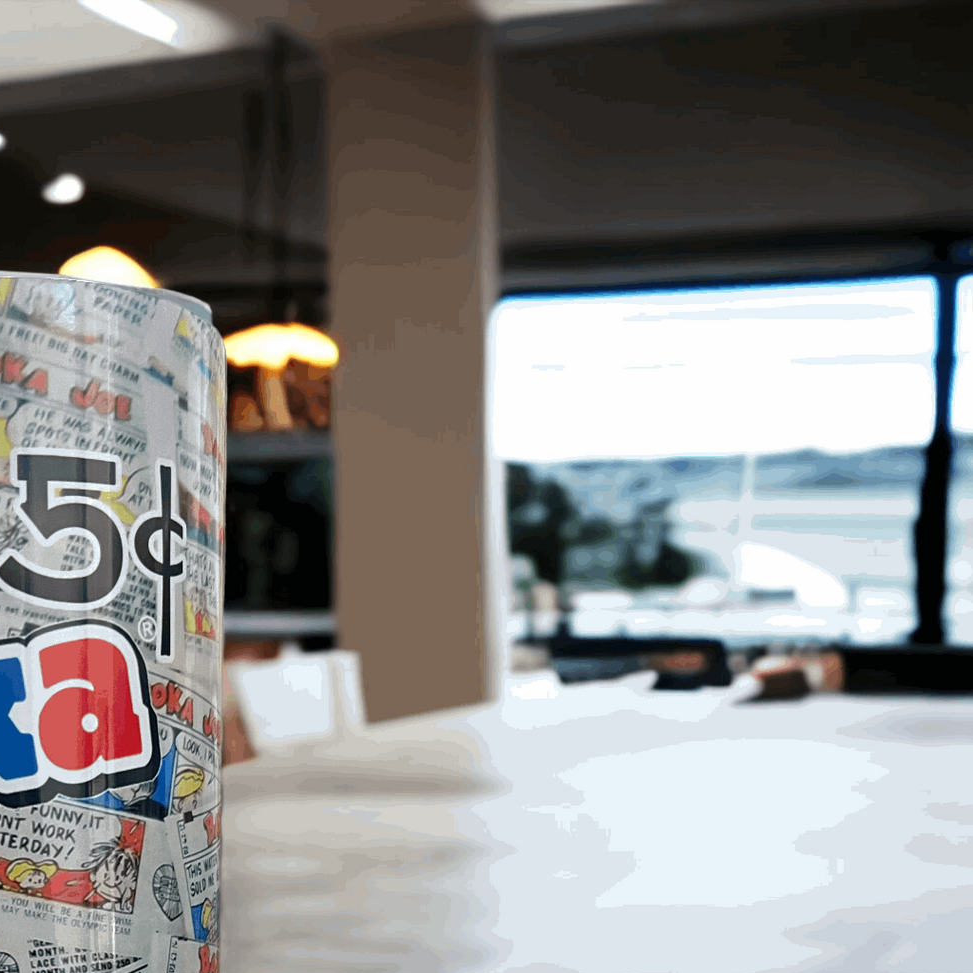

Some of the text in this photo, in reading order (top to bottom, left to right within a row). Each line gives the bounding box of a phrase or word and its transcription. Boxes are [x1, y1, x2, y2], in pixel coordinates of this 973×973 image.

[69, 379, 132, 422] JOE
[31, 821, 76, 845] WORK
[186, 859, 202, 880] THIS
[190, 879, 207, 898] SOLD
[1, 903, 21, 915] MAY
[24, 908, 49, 920] MAKE
[52, 915, 68, 927] THE
[11, 897, 29, 911] YOU
[34, 901, 55, 916] WILL
[60, 906, 72, 918] BE
[30, 954, 87, 969] LACE WITH
[90, 961, 113, 972] SEND
